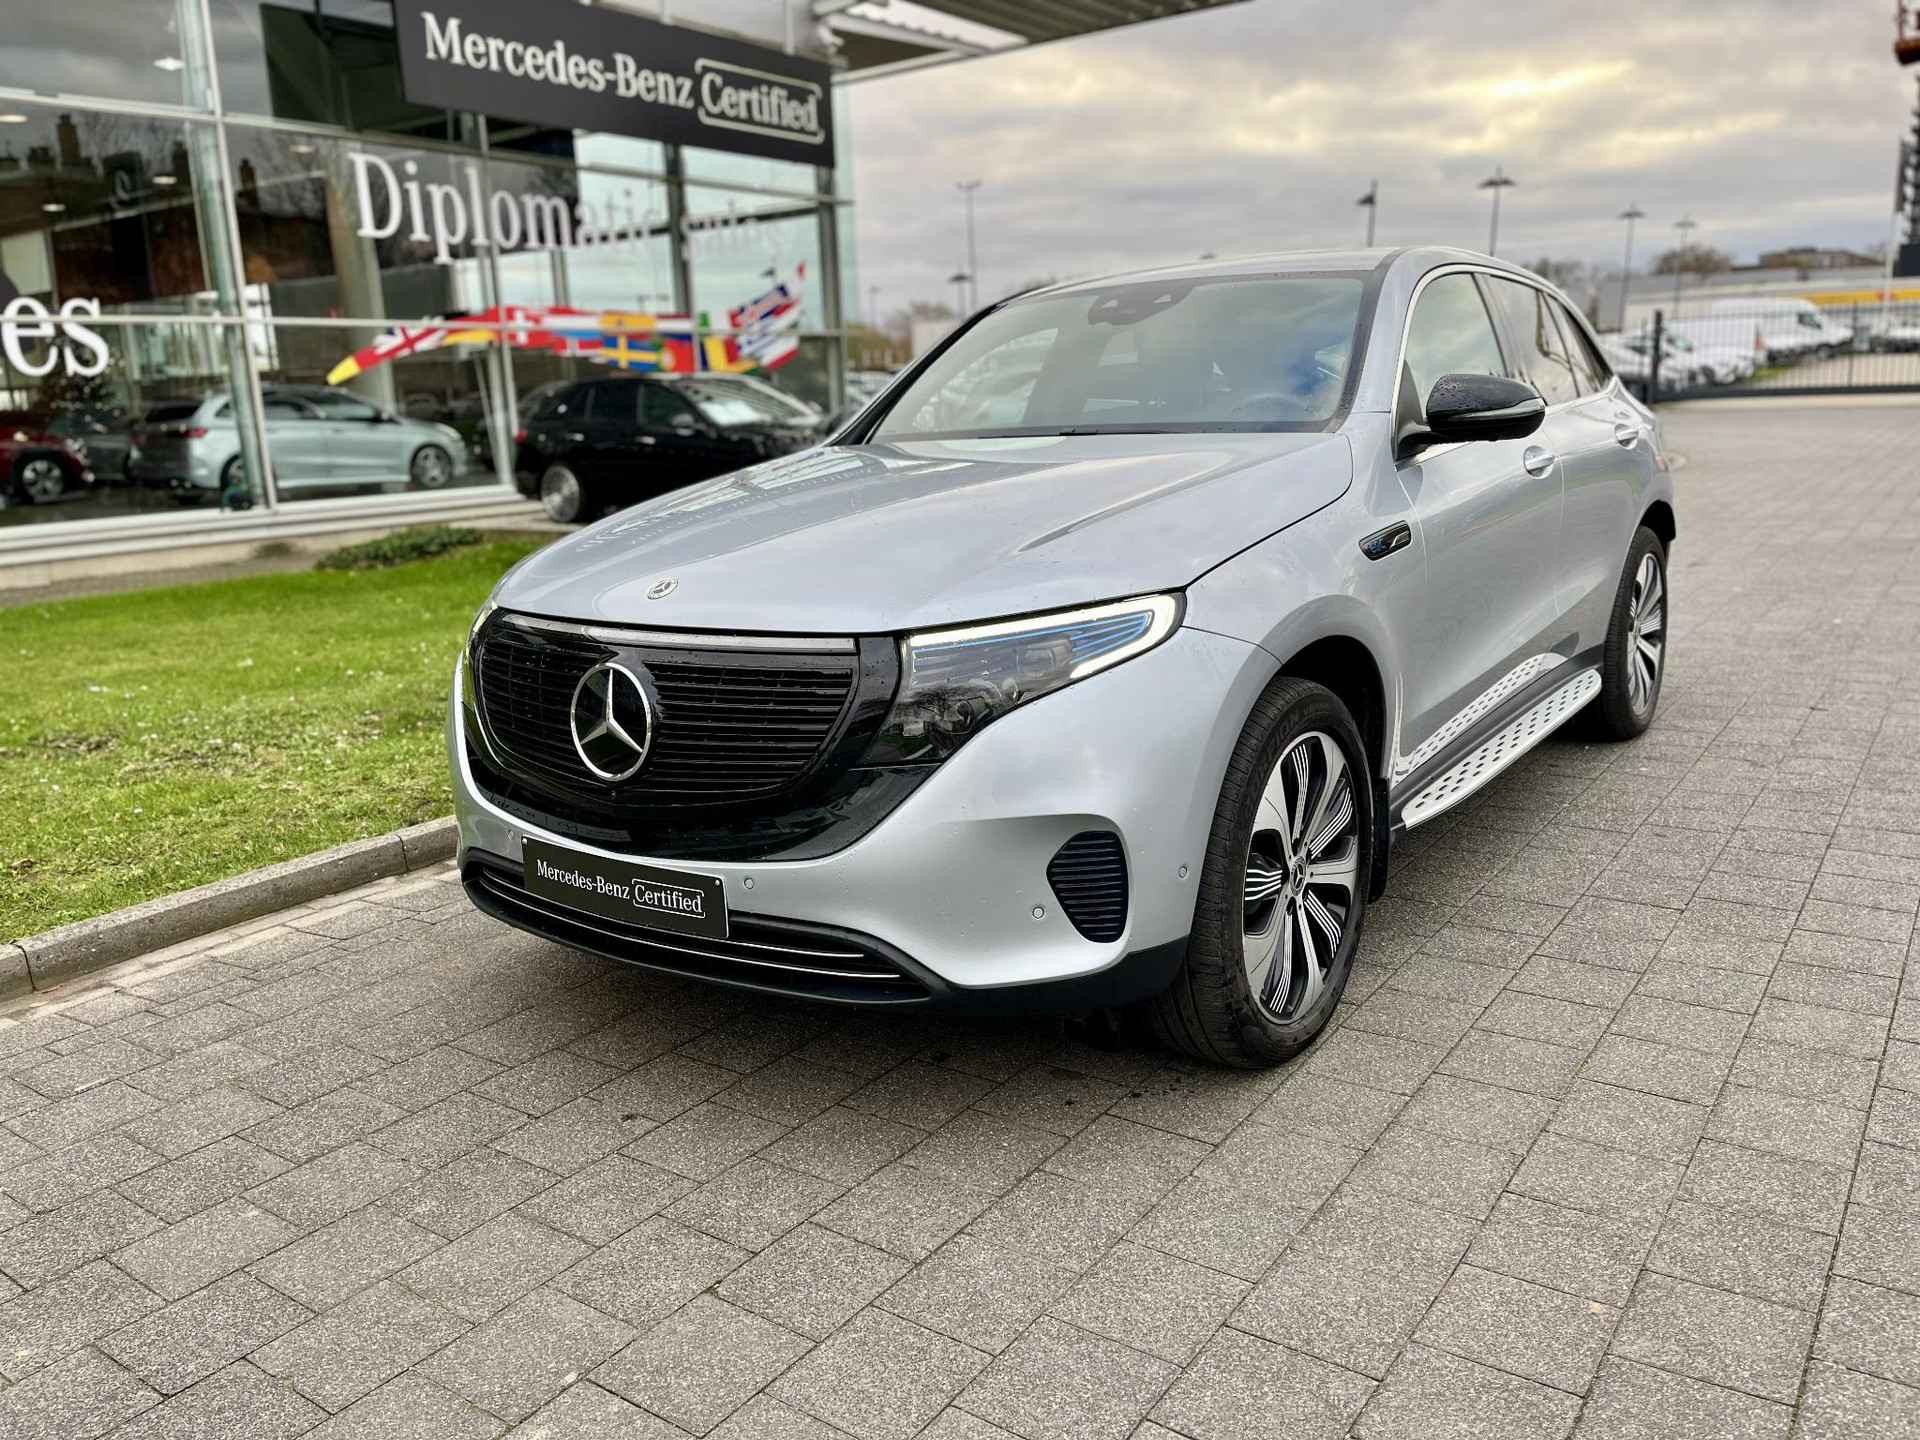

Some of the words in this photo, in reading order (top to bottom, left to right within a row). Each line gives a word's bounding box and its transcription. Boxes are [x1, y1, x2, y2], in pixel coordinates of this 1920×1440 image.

[421, 11, 694, 110] Mercedes-Benz
[700, 73, 818, 133] Certified
[536, 859, 630, 900] Mercedes-Benz
[634, 884, 702, 913] Certified
